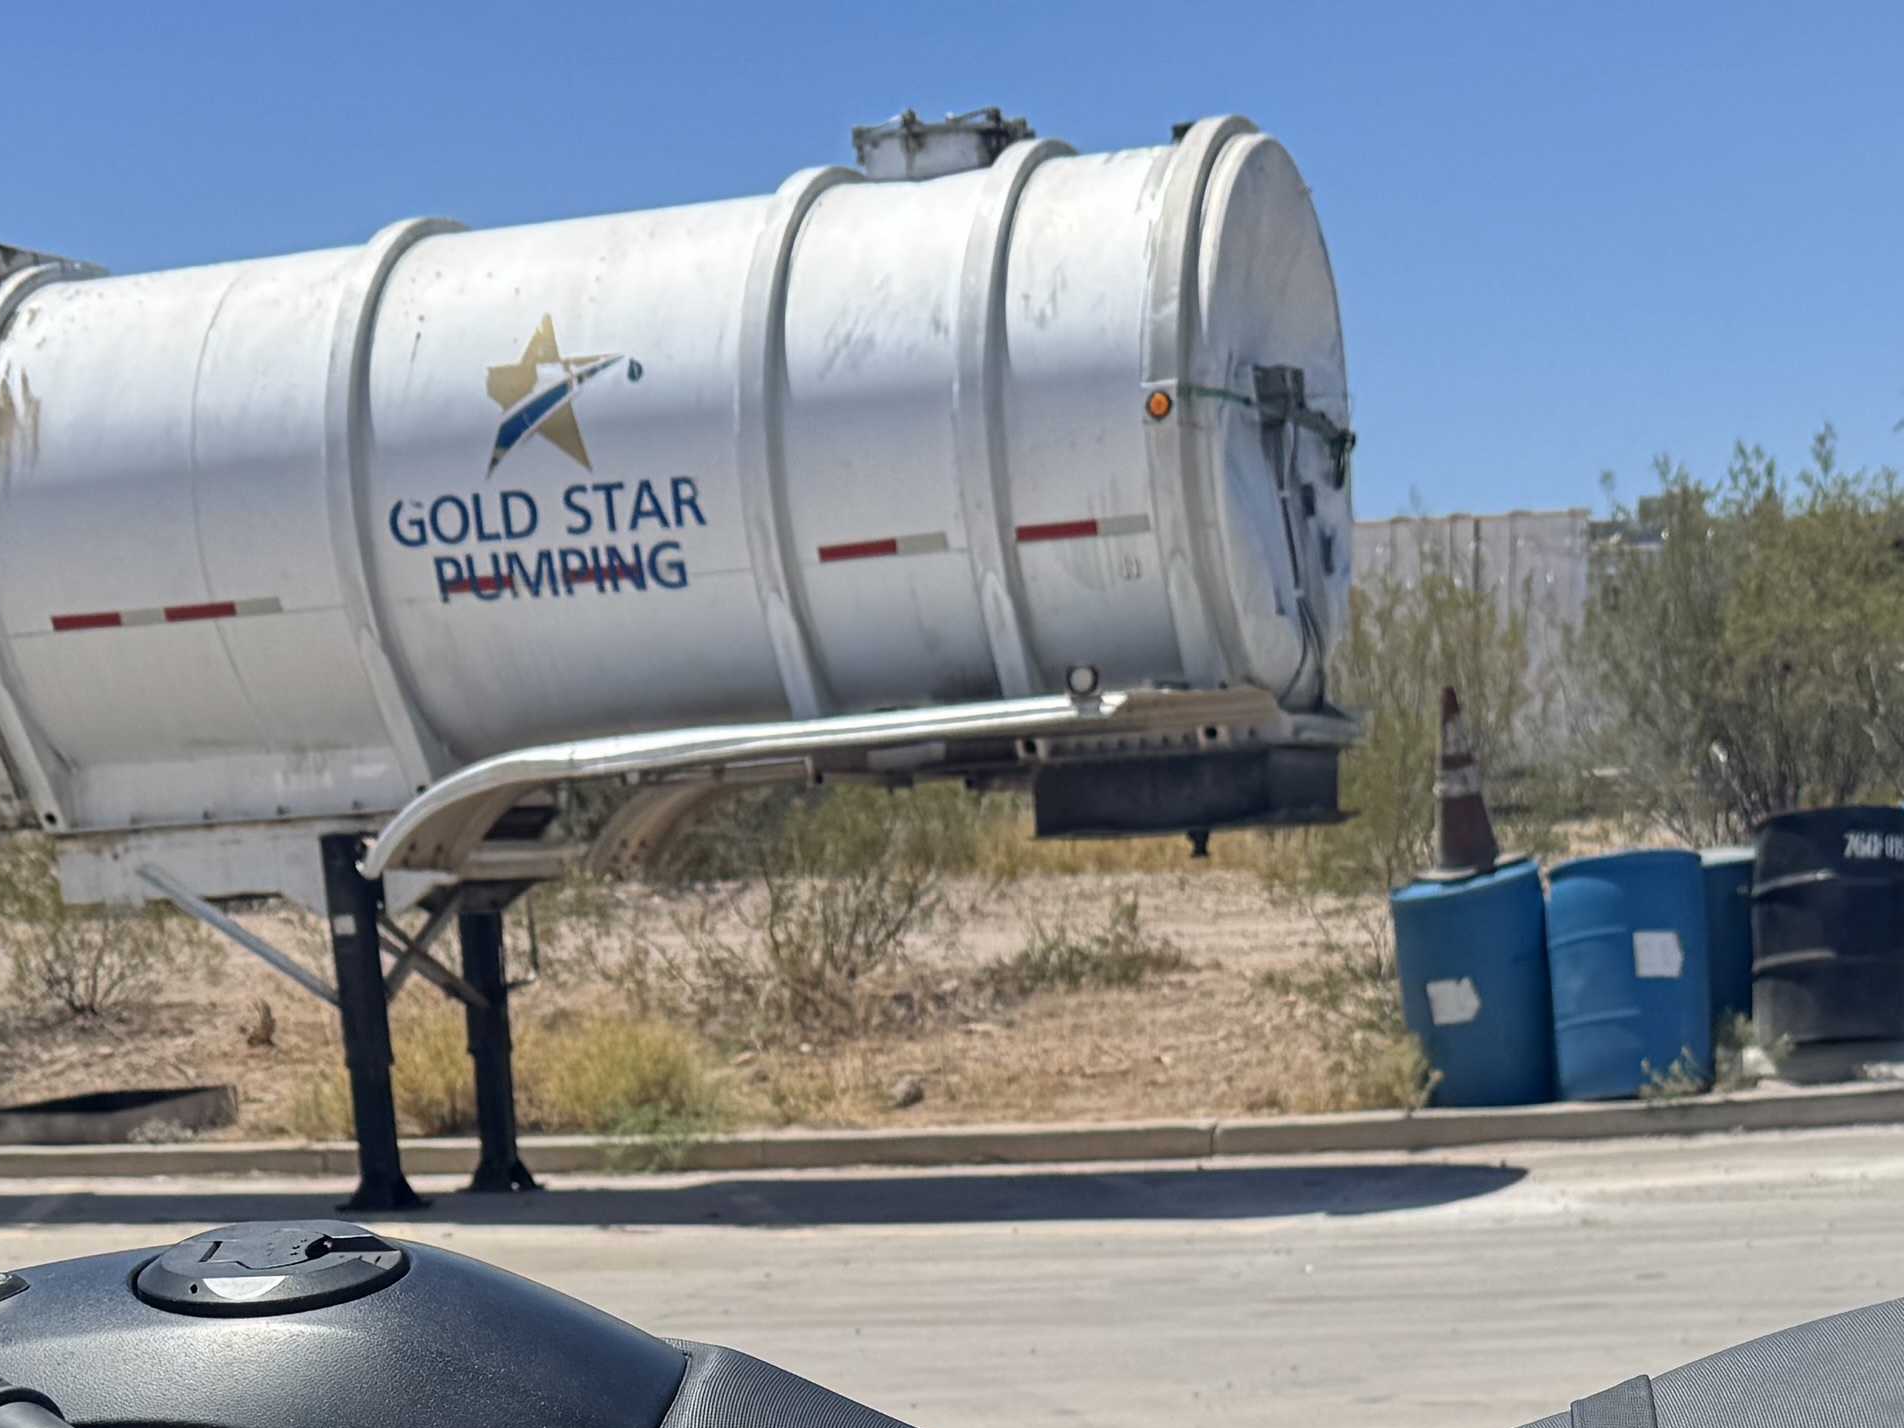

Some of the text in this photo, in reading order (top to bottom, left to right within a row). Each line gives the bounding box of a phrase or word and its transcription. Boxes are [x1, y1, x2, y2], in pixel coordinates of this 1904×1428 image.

[389, 476, 708, 548] GOLD STAR
[433, 540, 689, 603] PUMPING
